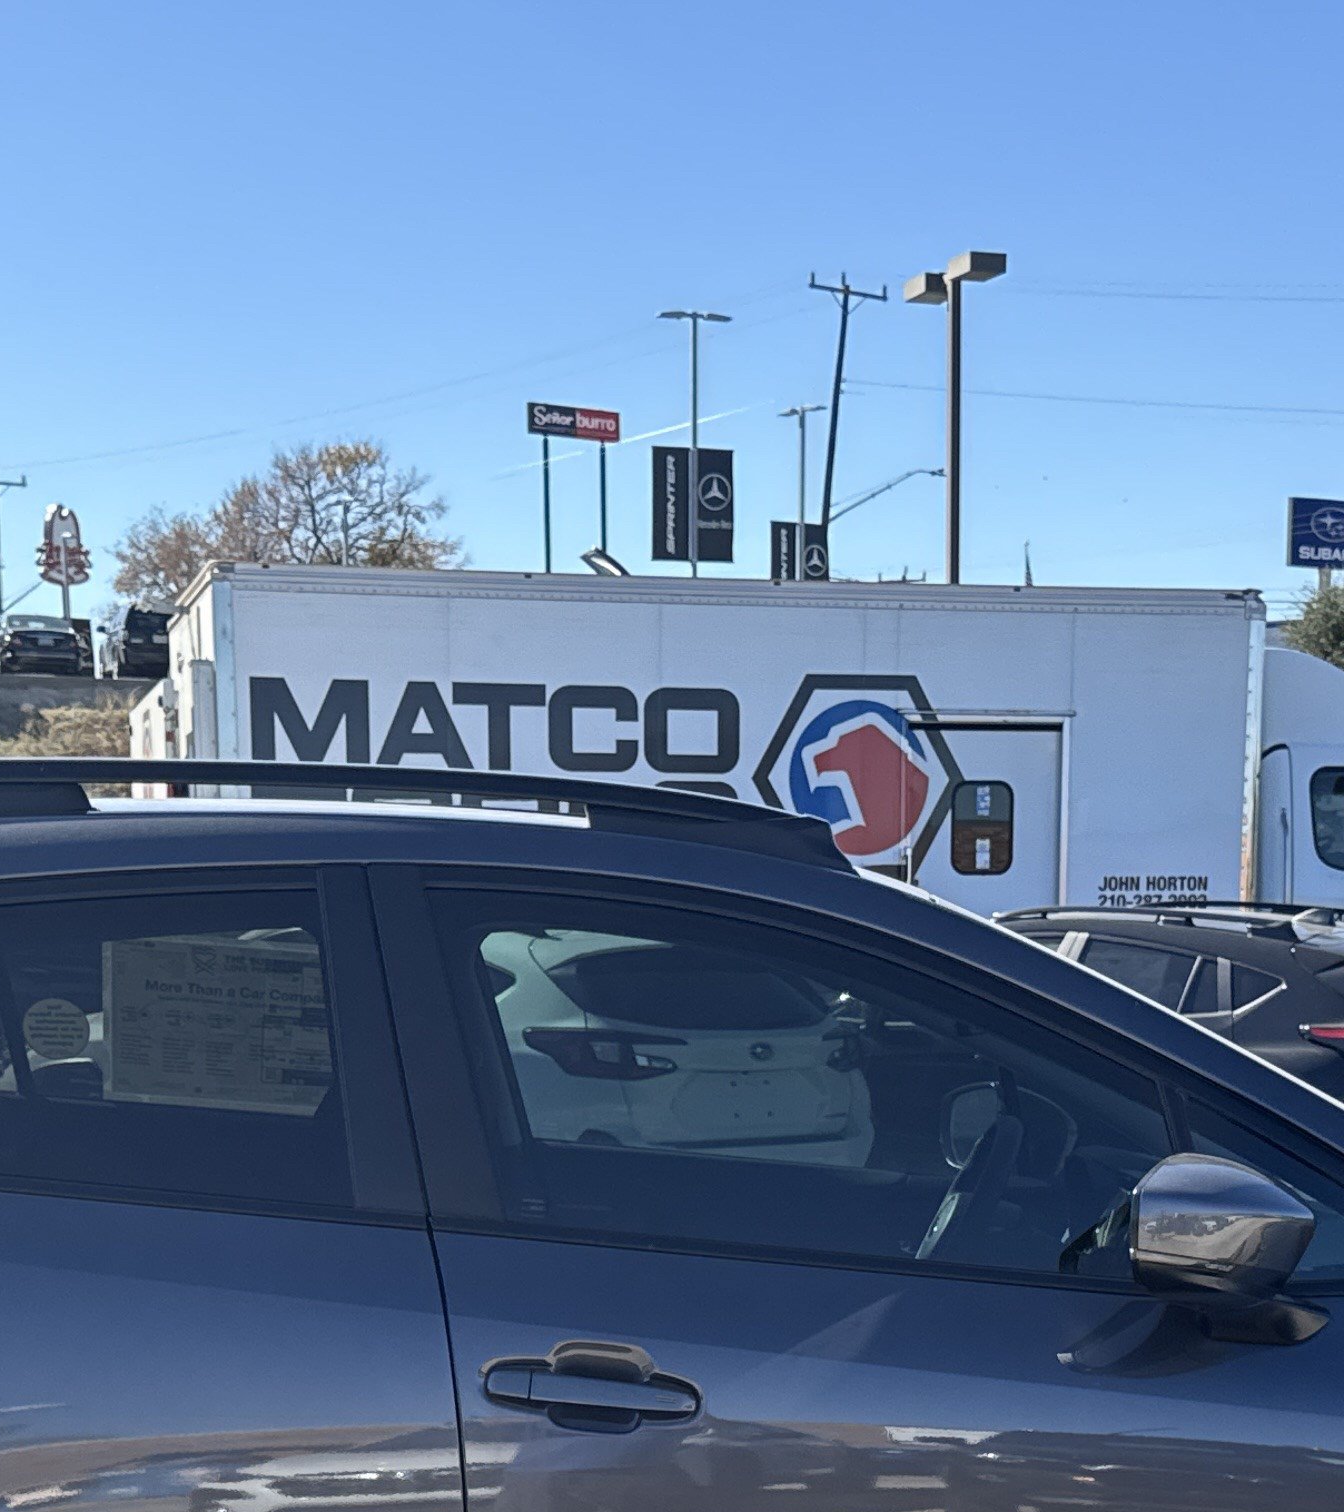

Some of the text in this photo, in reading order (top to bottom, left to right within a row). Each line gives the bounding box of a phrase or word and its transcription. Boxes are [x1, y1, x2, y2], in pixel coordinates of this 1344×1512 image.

[575, 412, 617, 432] burro
[665, 455, 677, 554] SPRINTER
[249, 675, 741, 774] MATCO
[1098, 876, 1208, 892] JOHN HORTON
[145, 978, 183, 994] More
[187, 982, 224, 998] Than
[227, 987, 236, 998] a
[240, 986, 266, 1001] Car
[269, 988, 327, 1005] Compa
